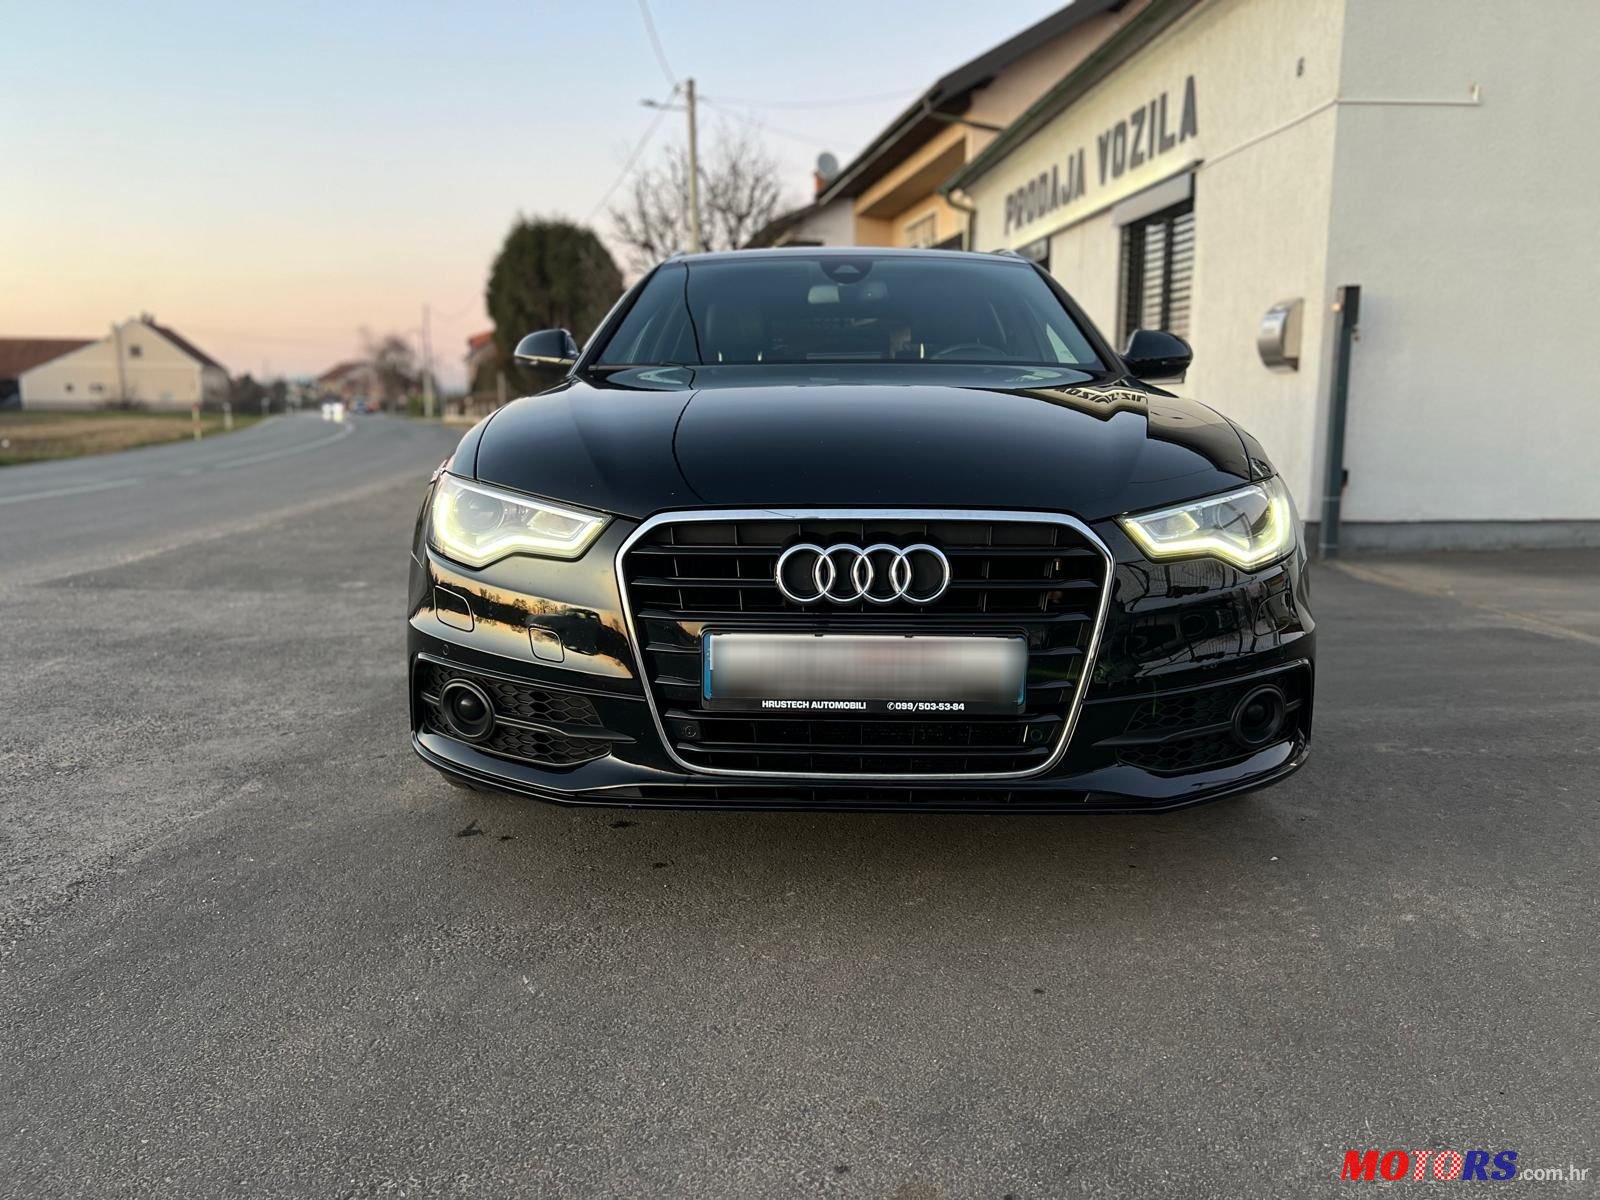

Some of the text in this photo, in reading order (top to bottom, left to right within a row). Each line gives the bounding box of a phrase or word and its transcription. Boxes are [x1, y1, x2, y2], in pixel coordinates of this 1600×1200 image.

[1004, 74, 1198, 236] PRODAJA VOZILA
[762, 700, 809, 709] HRUSTECH
[811, 701, 866, 710] AUTOMOBILI
